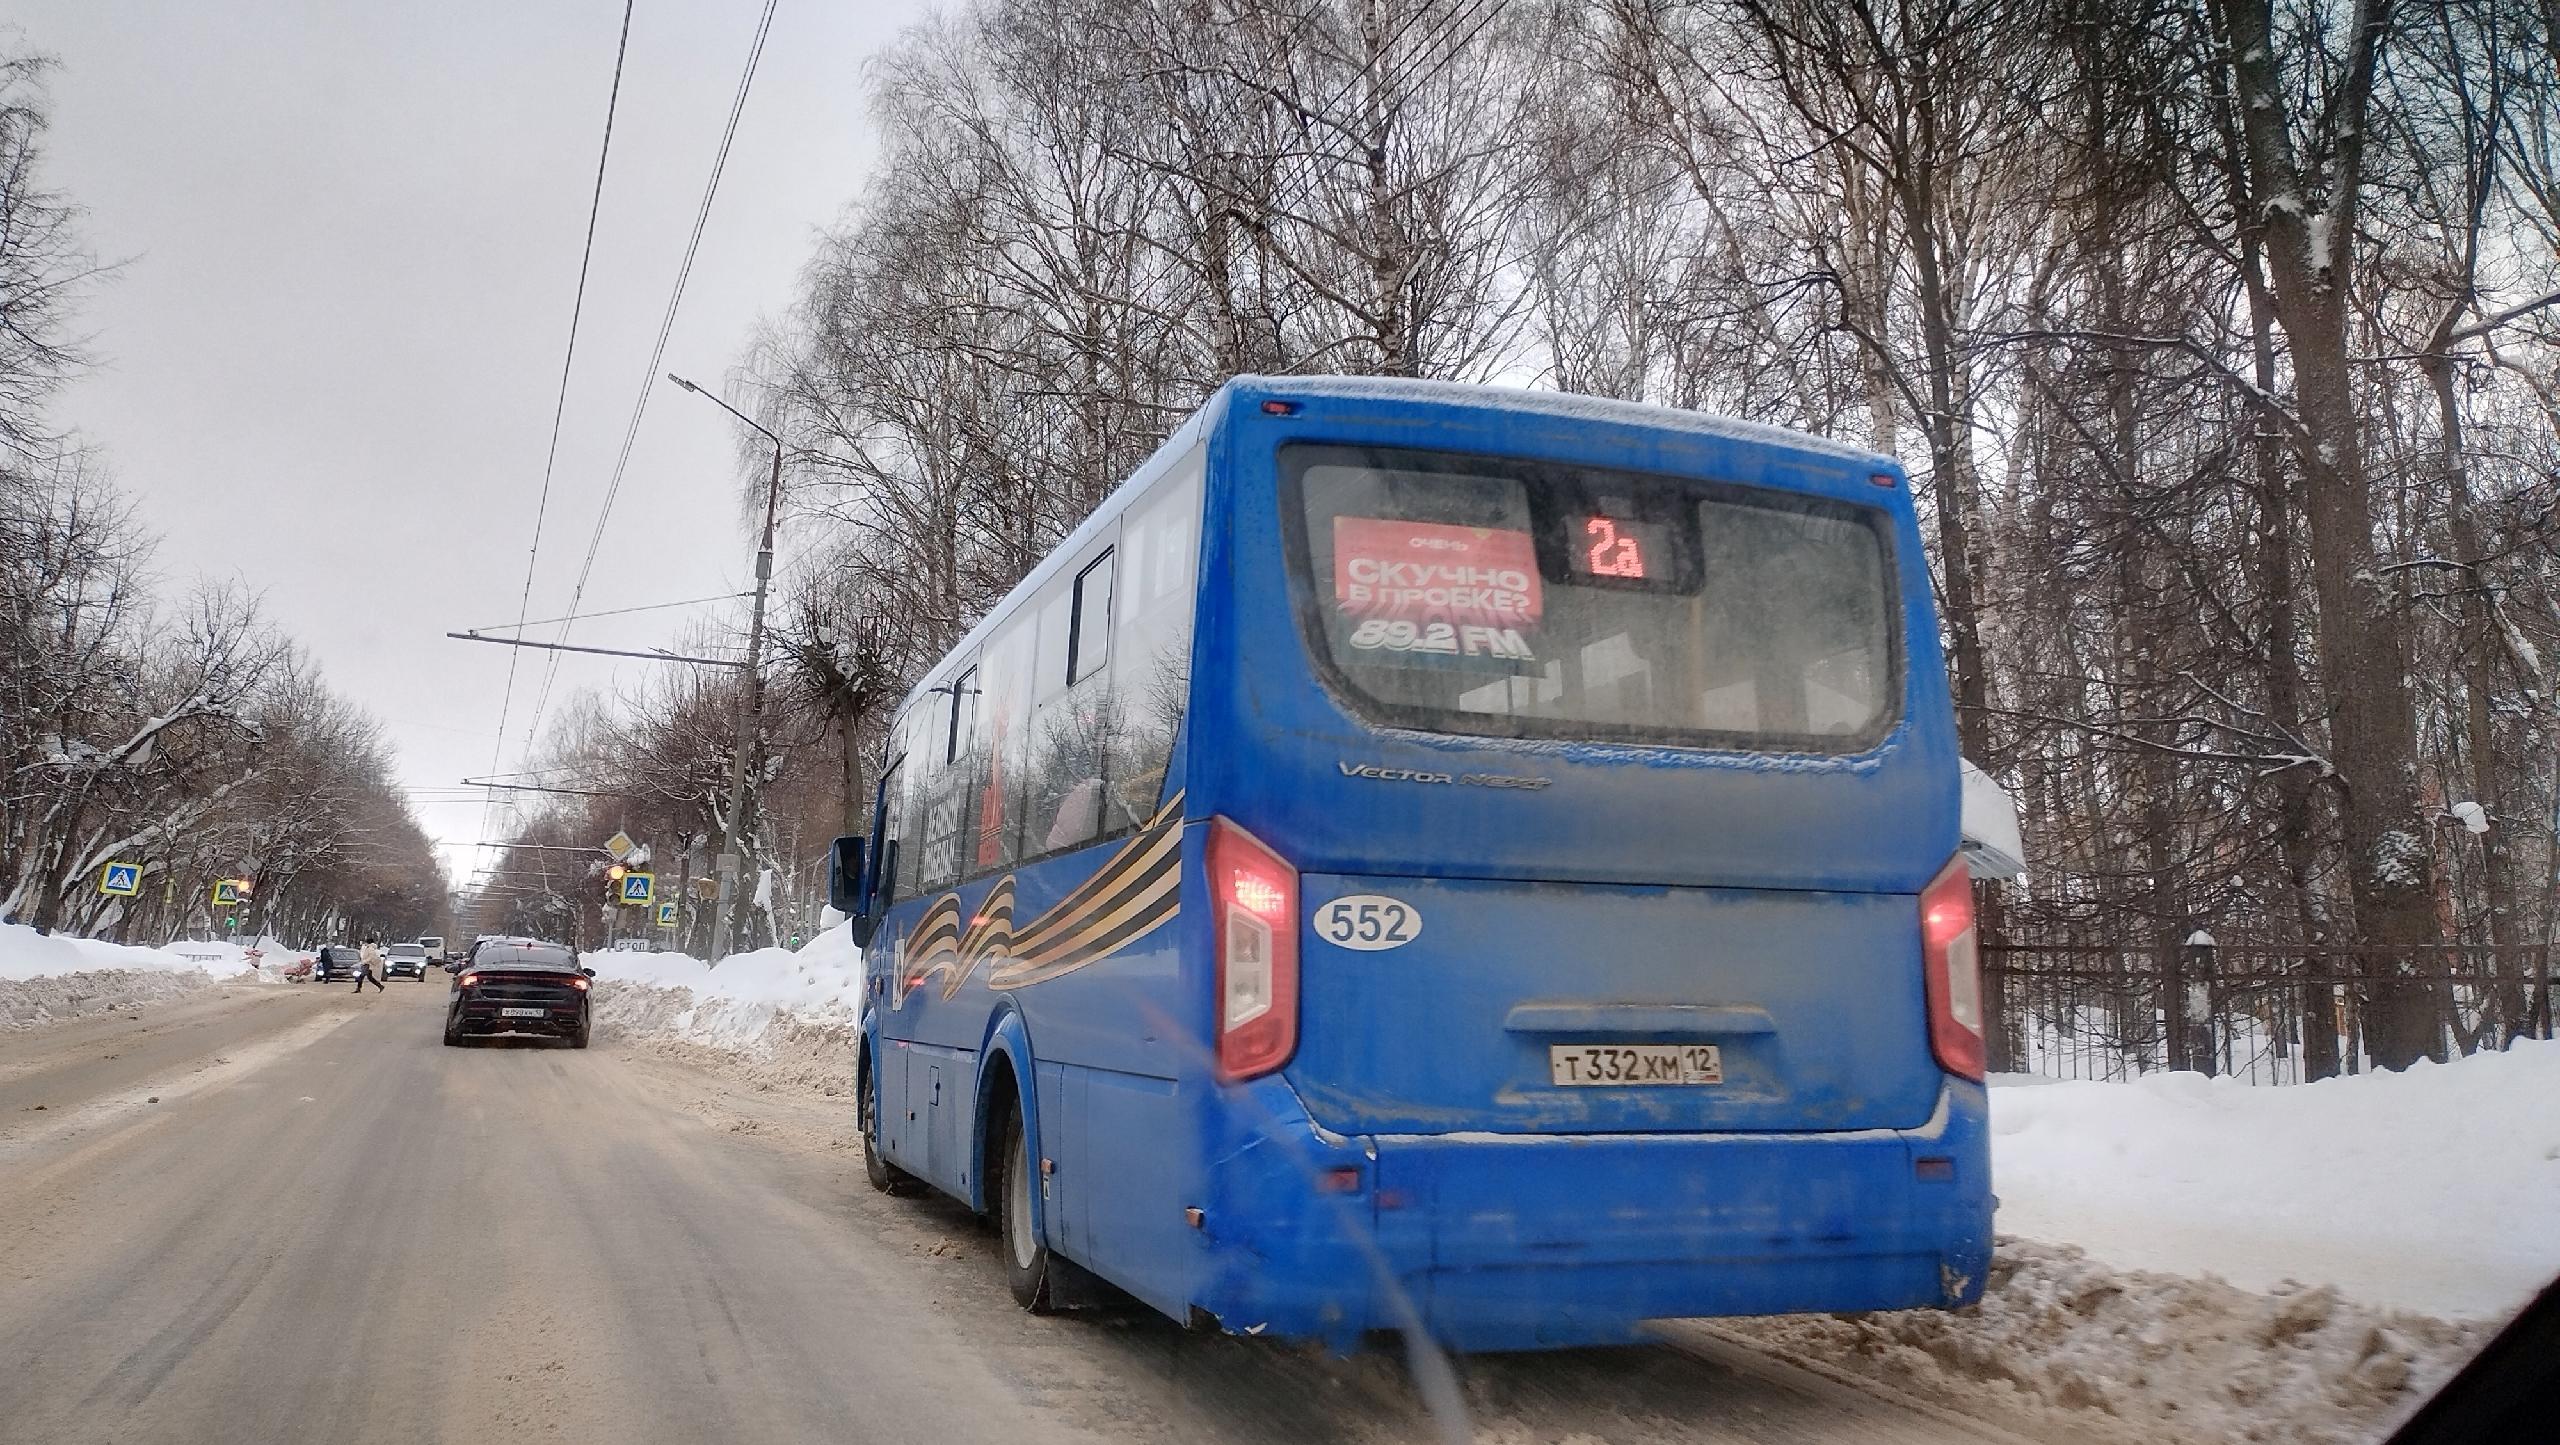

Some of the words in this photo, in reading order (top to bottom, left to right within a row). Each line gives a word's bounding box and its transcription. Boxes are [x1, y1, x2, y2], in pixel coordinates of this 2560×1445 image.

[1348, 558, 1530, 593] СКУЧНО
[1349, 583, 1373, 604] В
[1377, 586, 1531, 613] ПРОБКЕ?
[1350, 619, 1460, 655] 89.2
[1461, 625, 1536, 661] FM
[1338, 760, 1453, 785] VECTOR
[1331, 904, 1408, 942] 552
[1685, 1048, 1712, 1071] 12
